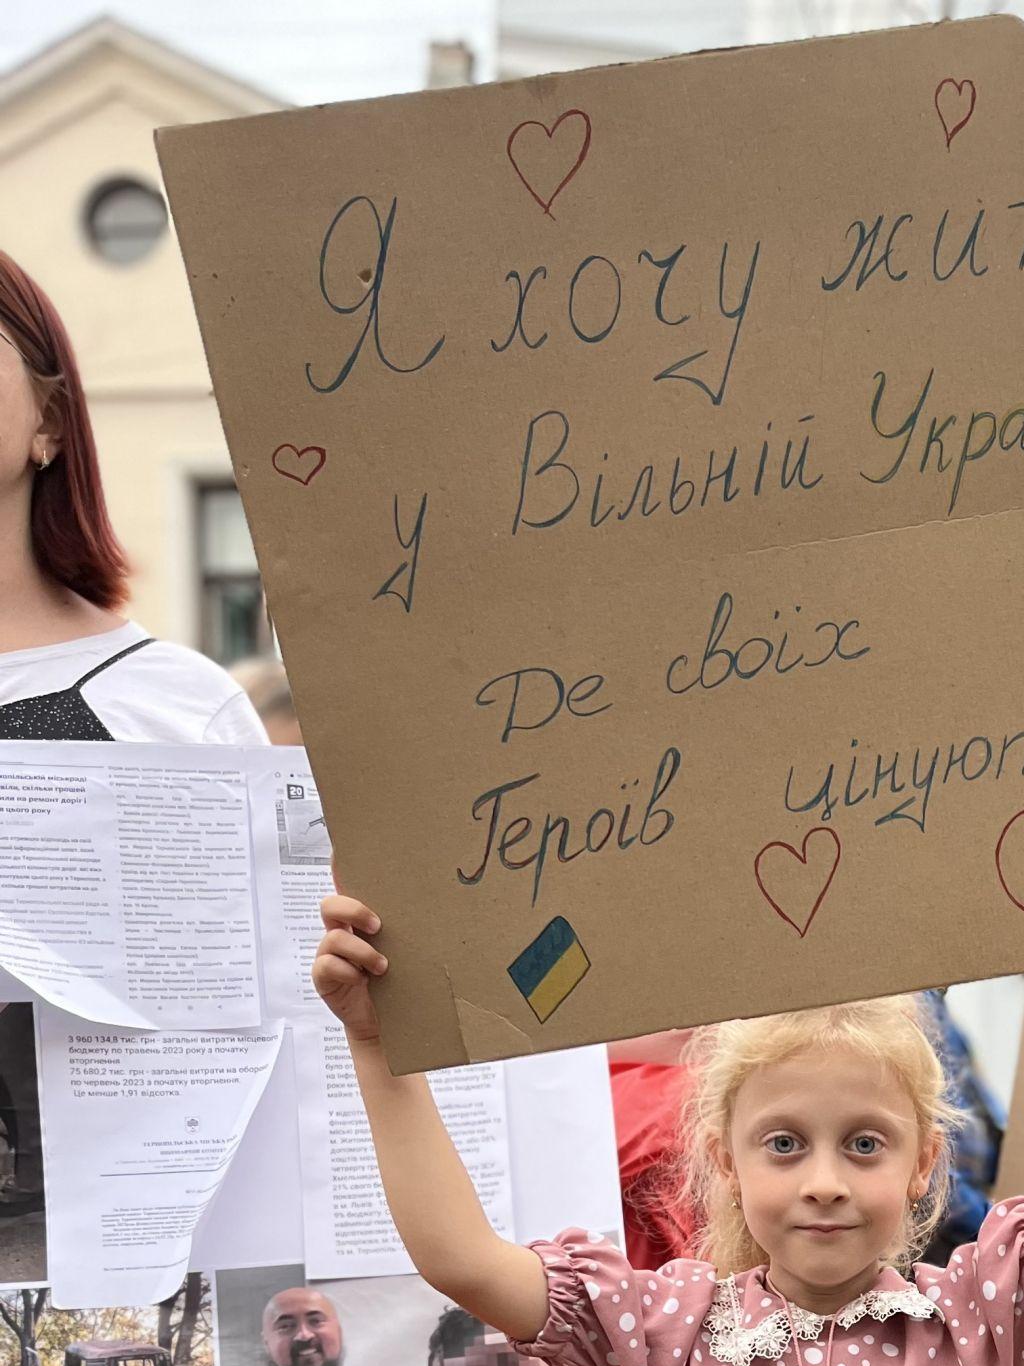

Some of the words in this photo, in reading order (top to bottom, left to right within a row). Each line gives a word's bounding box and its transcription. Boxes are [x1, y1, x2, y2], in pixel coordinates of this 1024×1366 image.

[306, 196, 445, 393] Я
[491, 241, 760, 405] хочу
[513, 410, 823, 535] Вільній
[476, 667, 613, 743] Де
[667, 592, 870, 694] своїх
[290, 786, 302, 796] 20
[457, 747, 681, 907] Героїв
[75, 1035, 92, 1043] 960
[200, 1035, 236, 1044] витрати
[162, 1046, 184, 1054] 2023
[214, 1046, 249, 1054] початку
[70, 1067, 81, 1075] 75
[123, 1078, 144, 1086] 2023
